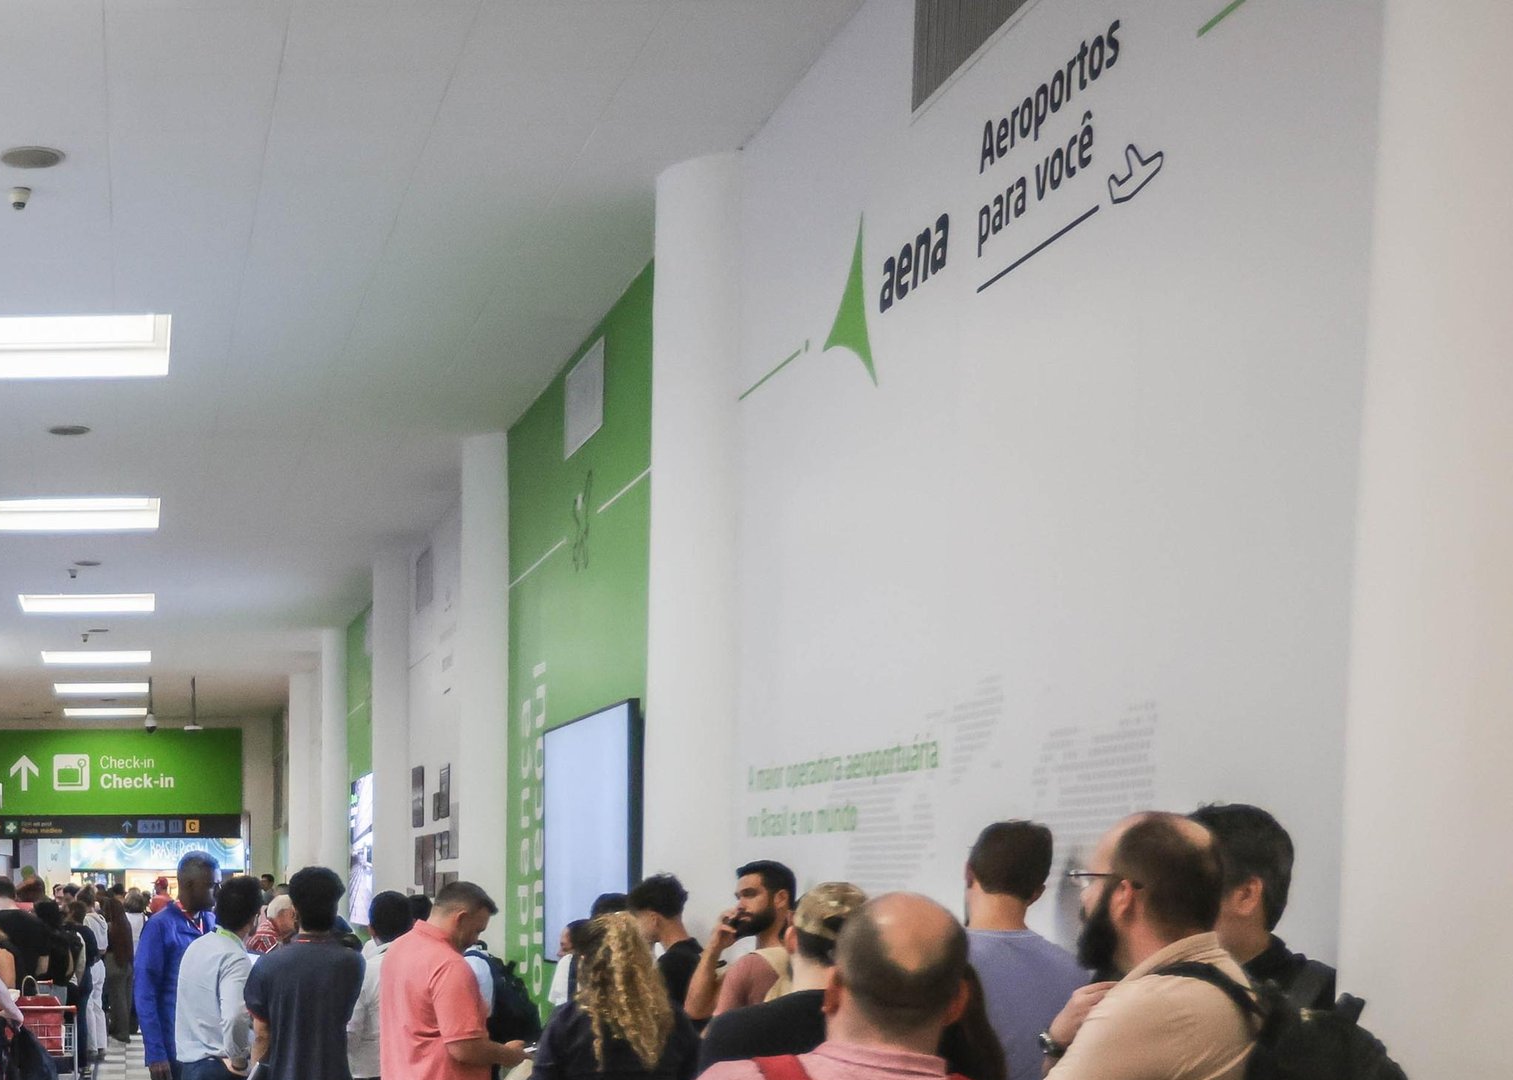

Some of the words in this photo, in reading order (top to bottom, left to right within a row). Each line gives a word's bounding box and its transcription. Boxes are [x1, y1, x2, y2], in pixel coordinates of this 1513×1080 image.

[979, 19, 1121, 174] Aeroportos
[977, 176, 1026, 258] para
[1034, 111, 1094, 201] você
[879, 212, 950, 313] aena
[99, 755, 155, 770] Check-in
[99, 773, 175, 789] Check-in
[188, 821, 196, 831] C
